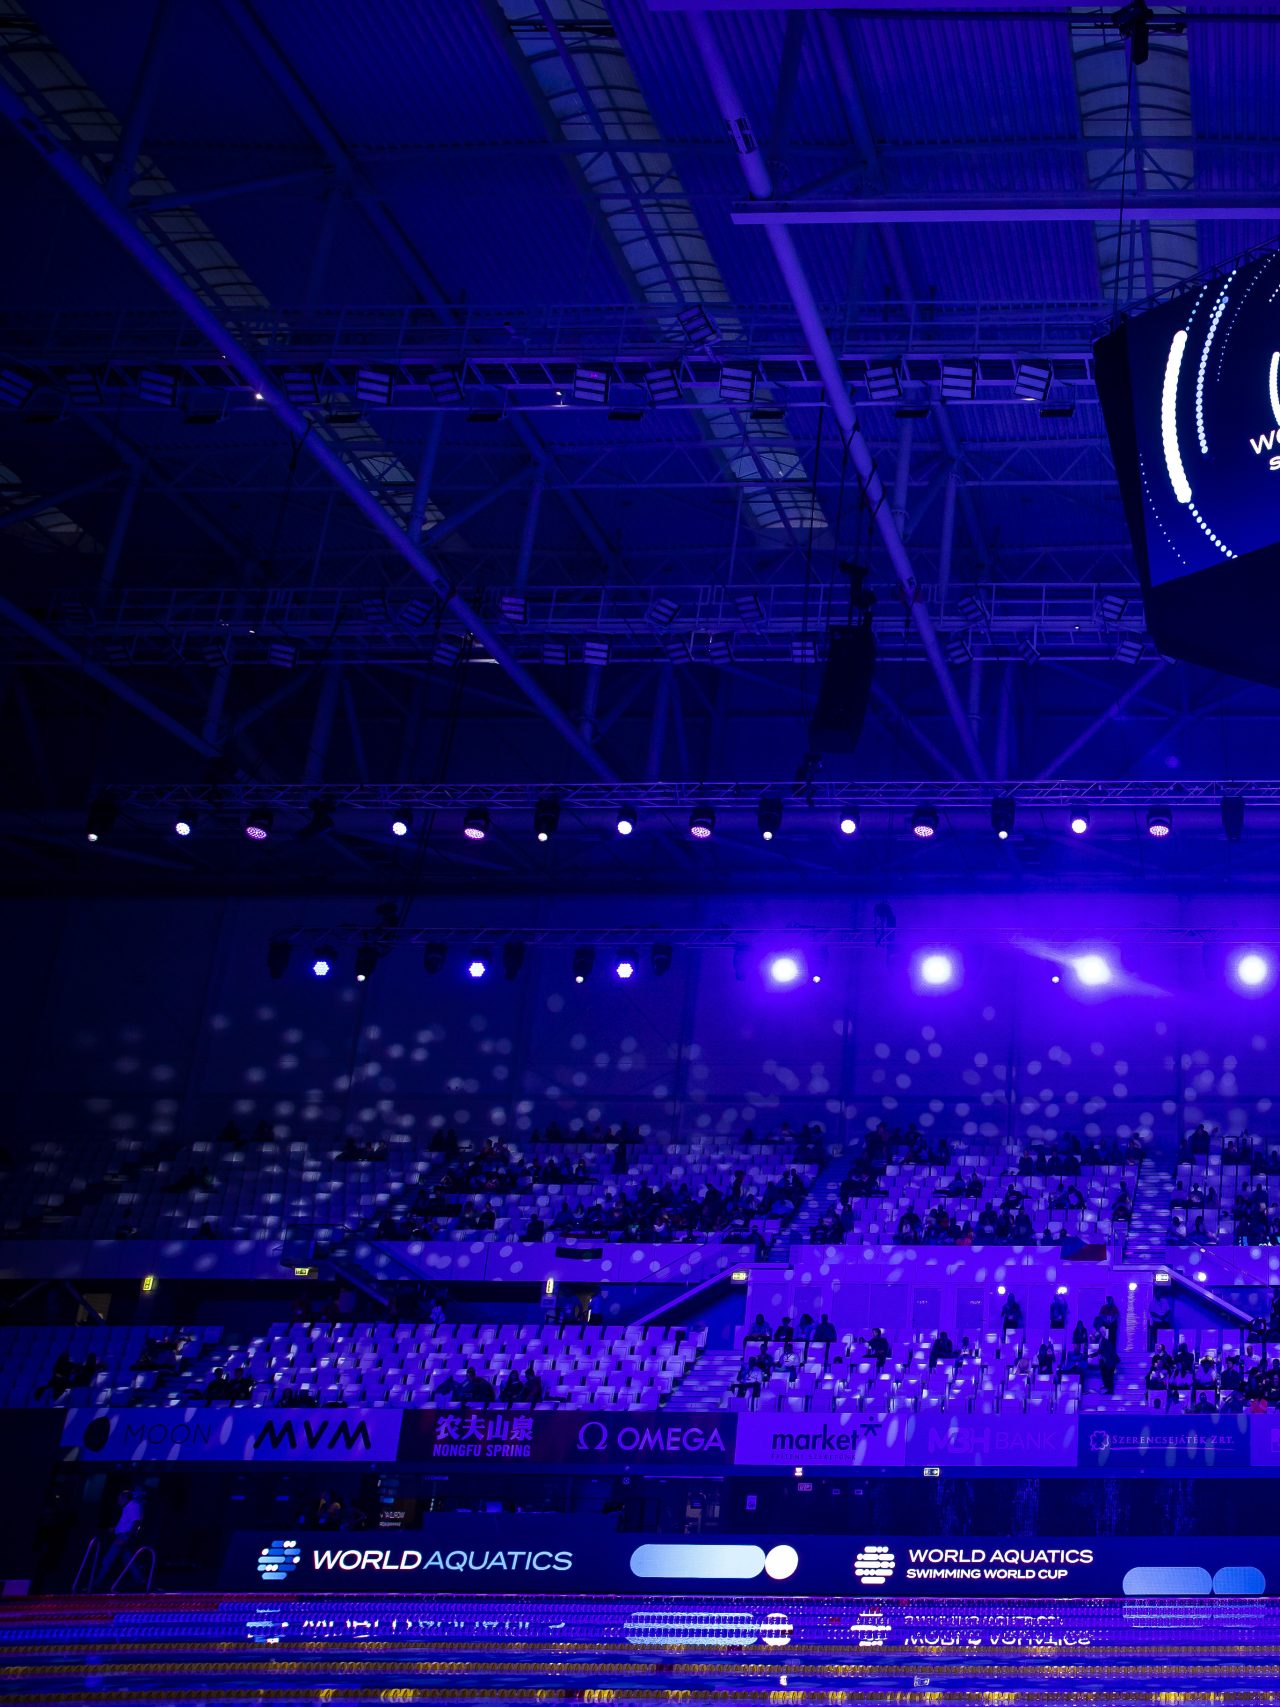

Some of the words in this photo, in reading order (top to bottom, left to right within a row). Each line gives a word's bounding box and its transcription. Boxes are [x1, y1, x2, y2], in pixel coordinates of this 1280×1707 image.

[123, 1421, 211, 1445] MOON
[253, 1419, 371, 1450] MVM
[434, 1414, 534, 1441] 农夫山泉
[616, 1426, 726, 1451] OMEGA
[770, 1422, 861, 1452] market
[432, 1443, 481, 1458] NONGFU
[485, 1443, 532, 1458] SPRING
[995, 1431, 1058, 1451] BANK
[312, 1549, 422, 1571] WORLD
[423, 1550, 574, 1573] AQUATICS
[908, 1549, 986, 1564] WORLD
[989, 1549, 1094, 1565] AQUATICS
[906, 1568, 982, 1579] SWIMMING
[983, 1569, 1036, 1580] WORLD
[1037, 1569, 1069, 1580] CUP
